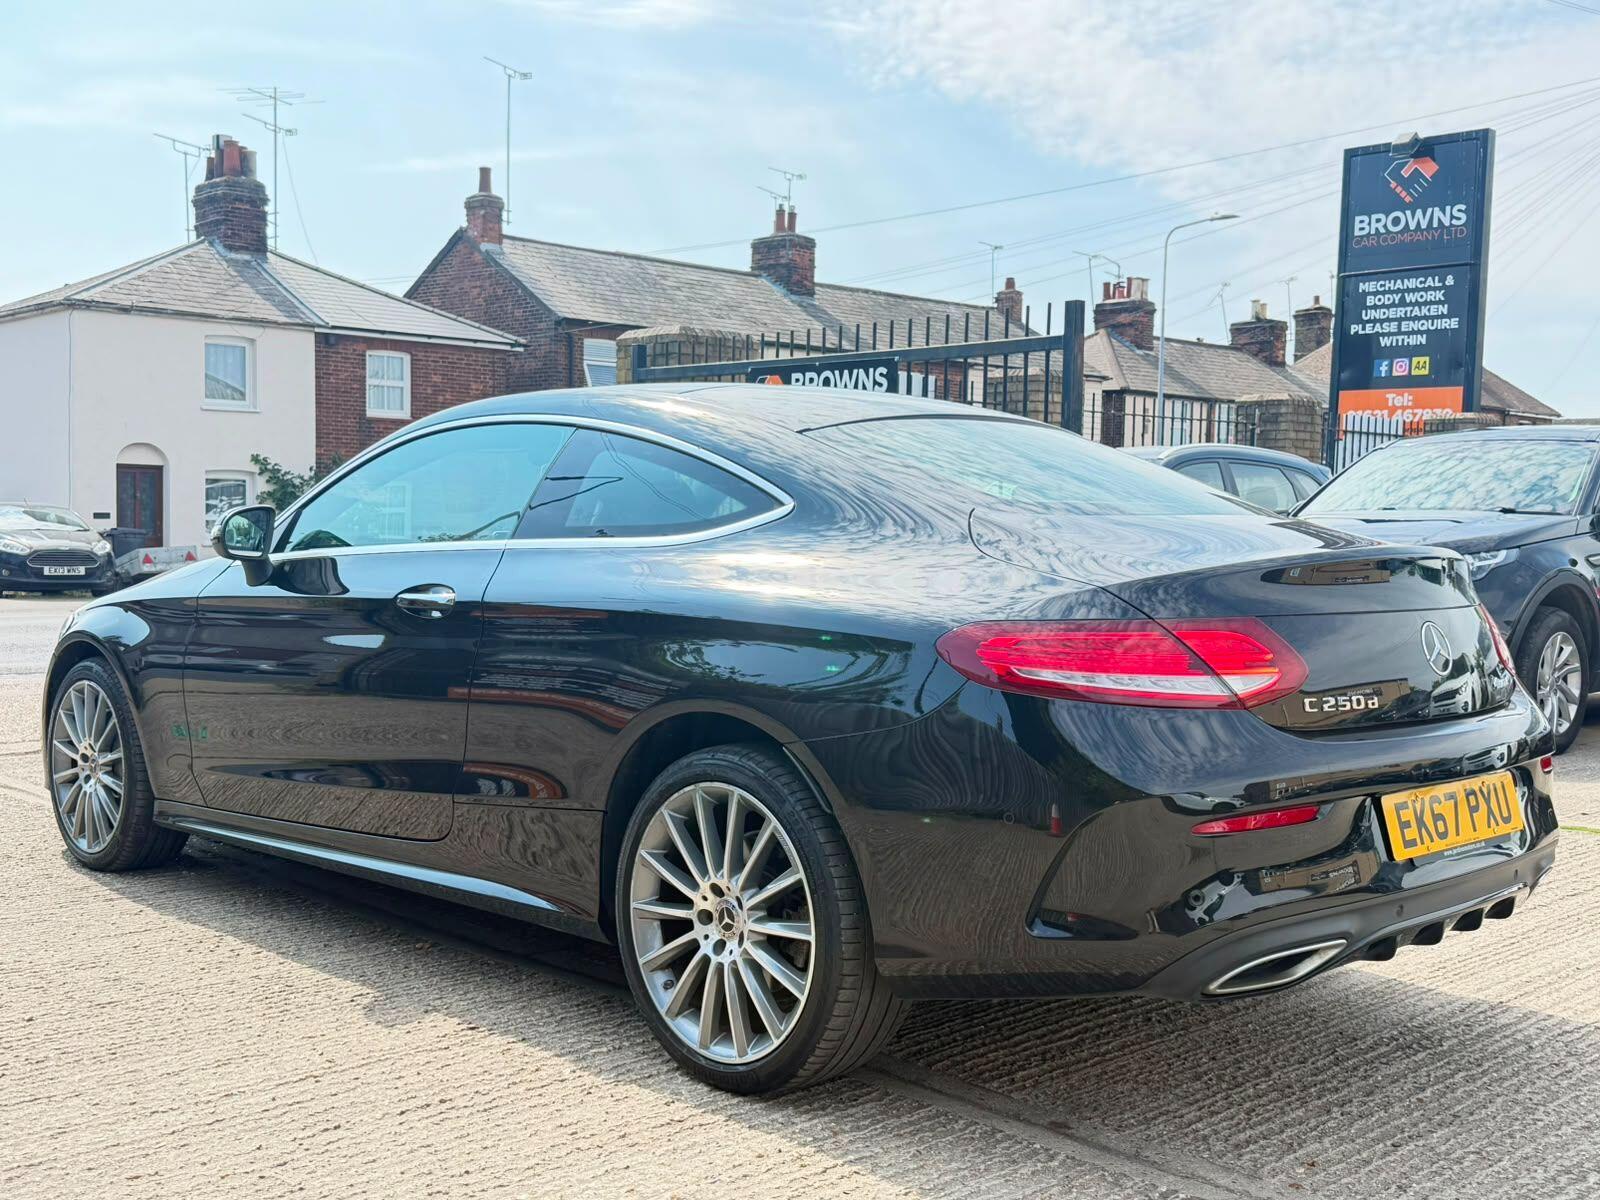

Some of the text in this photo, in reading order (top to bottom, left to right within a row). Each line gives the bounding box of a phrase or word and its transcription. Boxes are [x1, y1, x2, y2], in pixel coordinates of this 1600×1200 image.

[1354, 204, 1467, 236] BROWNS
[1352, 226, 1467, 248] CAR COMPANY LTD
[1359, 274, 1455, 293] MECHANICAL &
[1366, 290, 1446, 306] BODY WORK
[1362, 304, 1448, 320] UNDERTAKEN
[1350, 318, 1459, 335] PLEASE ENQUIRE
[1379, 334, 1427, 347] WITHIN
[1413, 360, 1427, 371] AA
[791, 367, 888, 392] BROWNS
[1386, 393, 1413, 407] Tel:
[1303, 695, 1379, 713] C 250d
[1394, 781, 1513, 849] EK67 PXU
